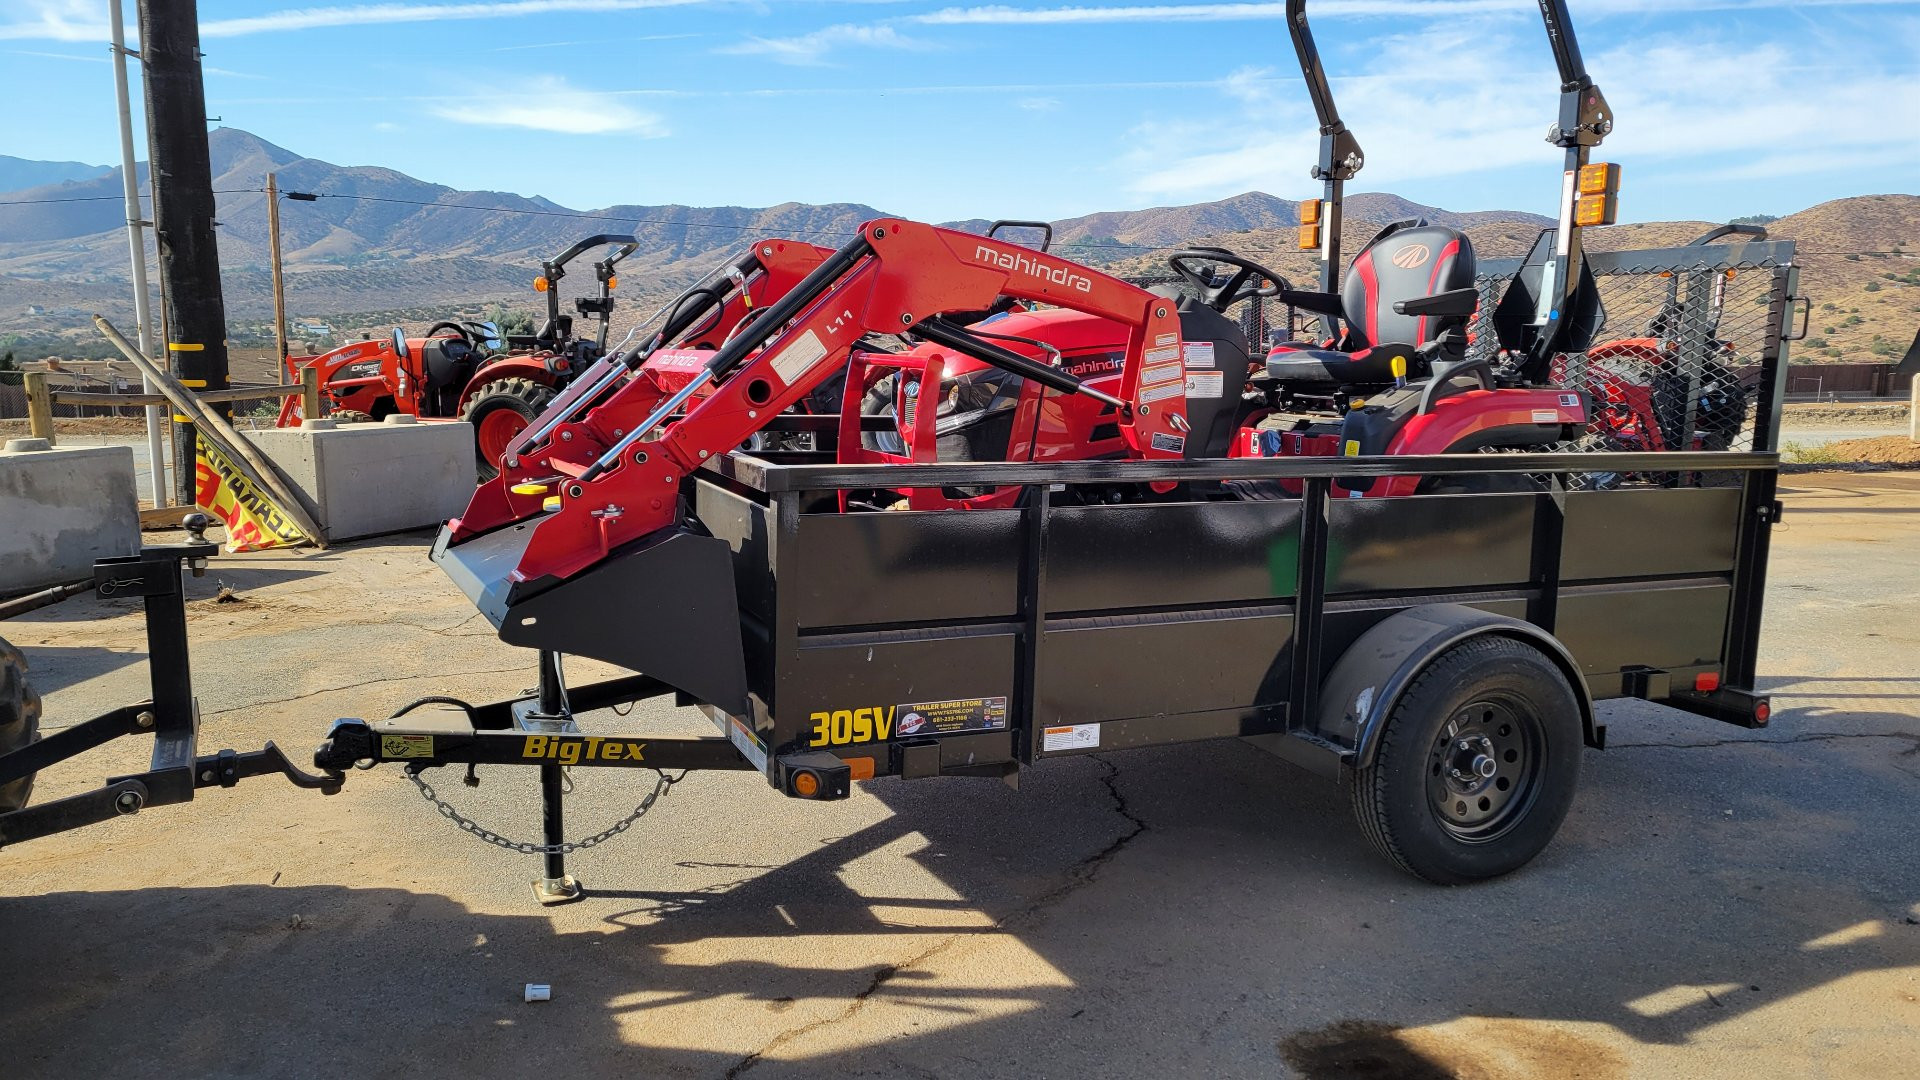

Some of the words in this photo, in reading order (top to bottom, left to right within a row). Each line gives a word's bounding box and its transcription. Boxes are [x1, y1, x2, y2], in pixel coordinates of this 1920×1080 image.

[975, 245, 1092, 293] mahindra
[826, 310, 853, 334] L11
[912, 703, 939, 711] TRAILER
[940, 701, 961, 709] SUPER
[810, 705, 896, 747] 30SV
[522, 735, 647, 765] BigTex
